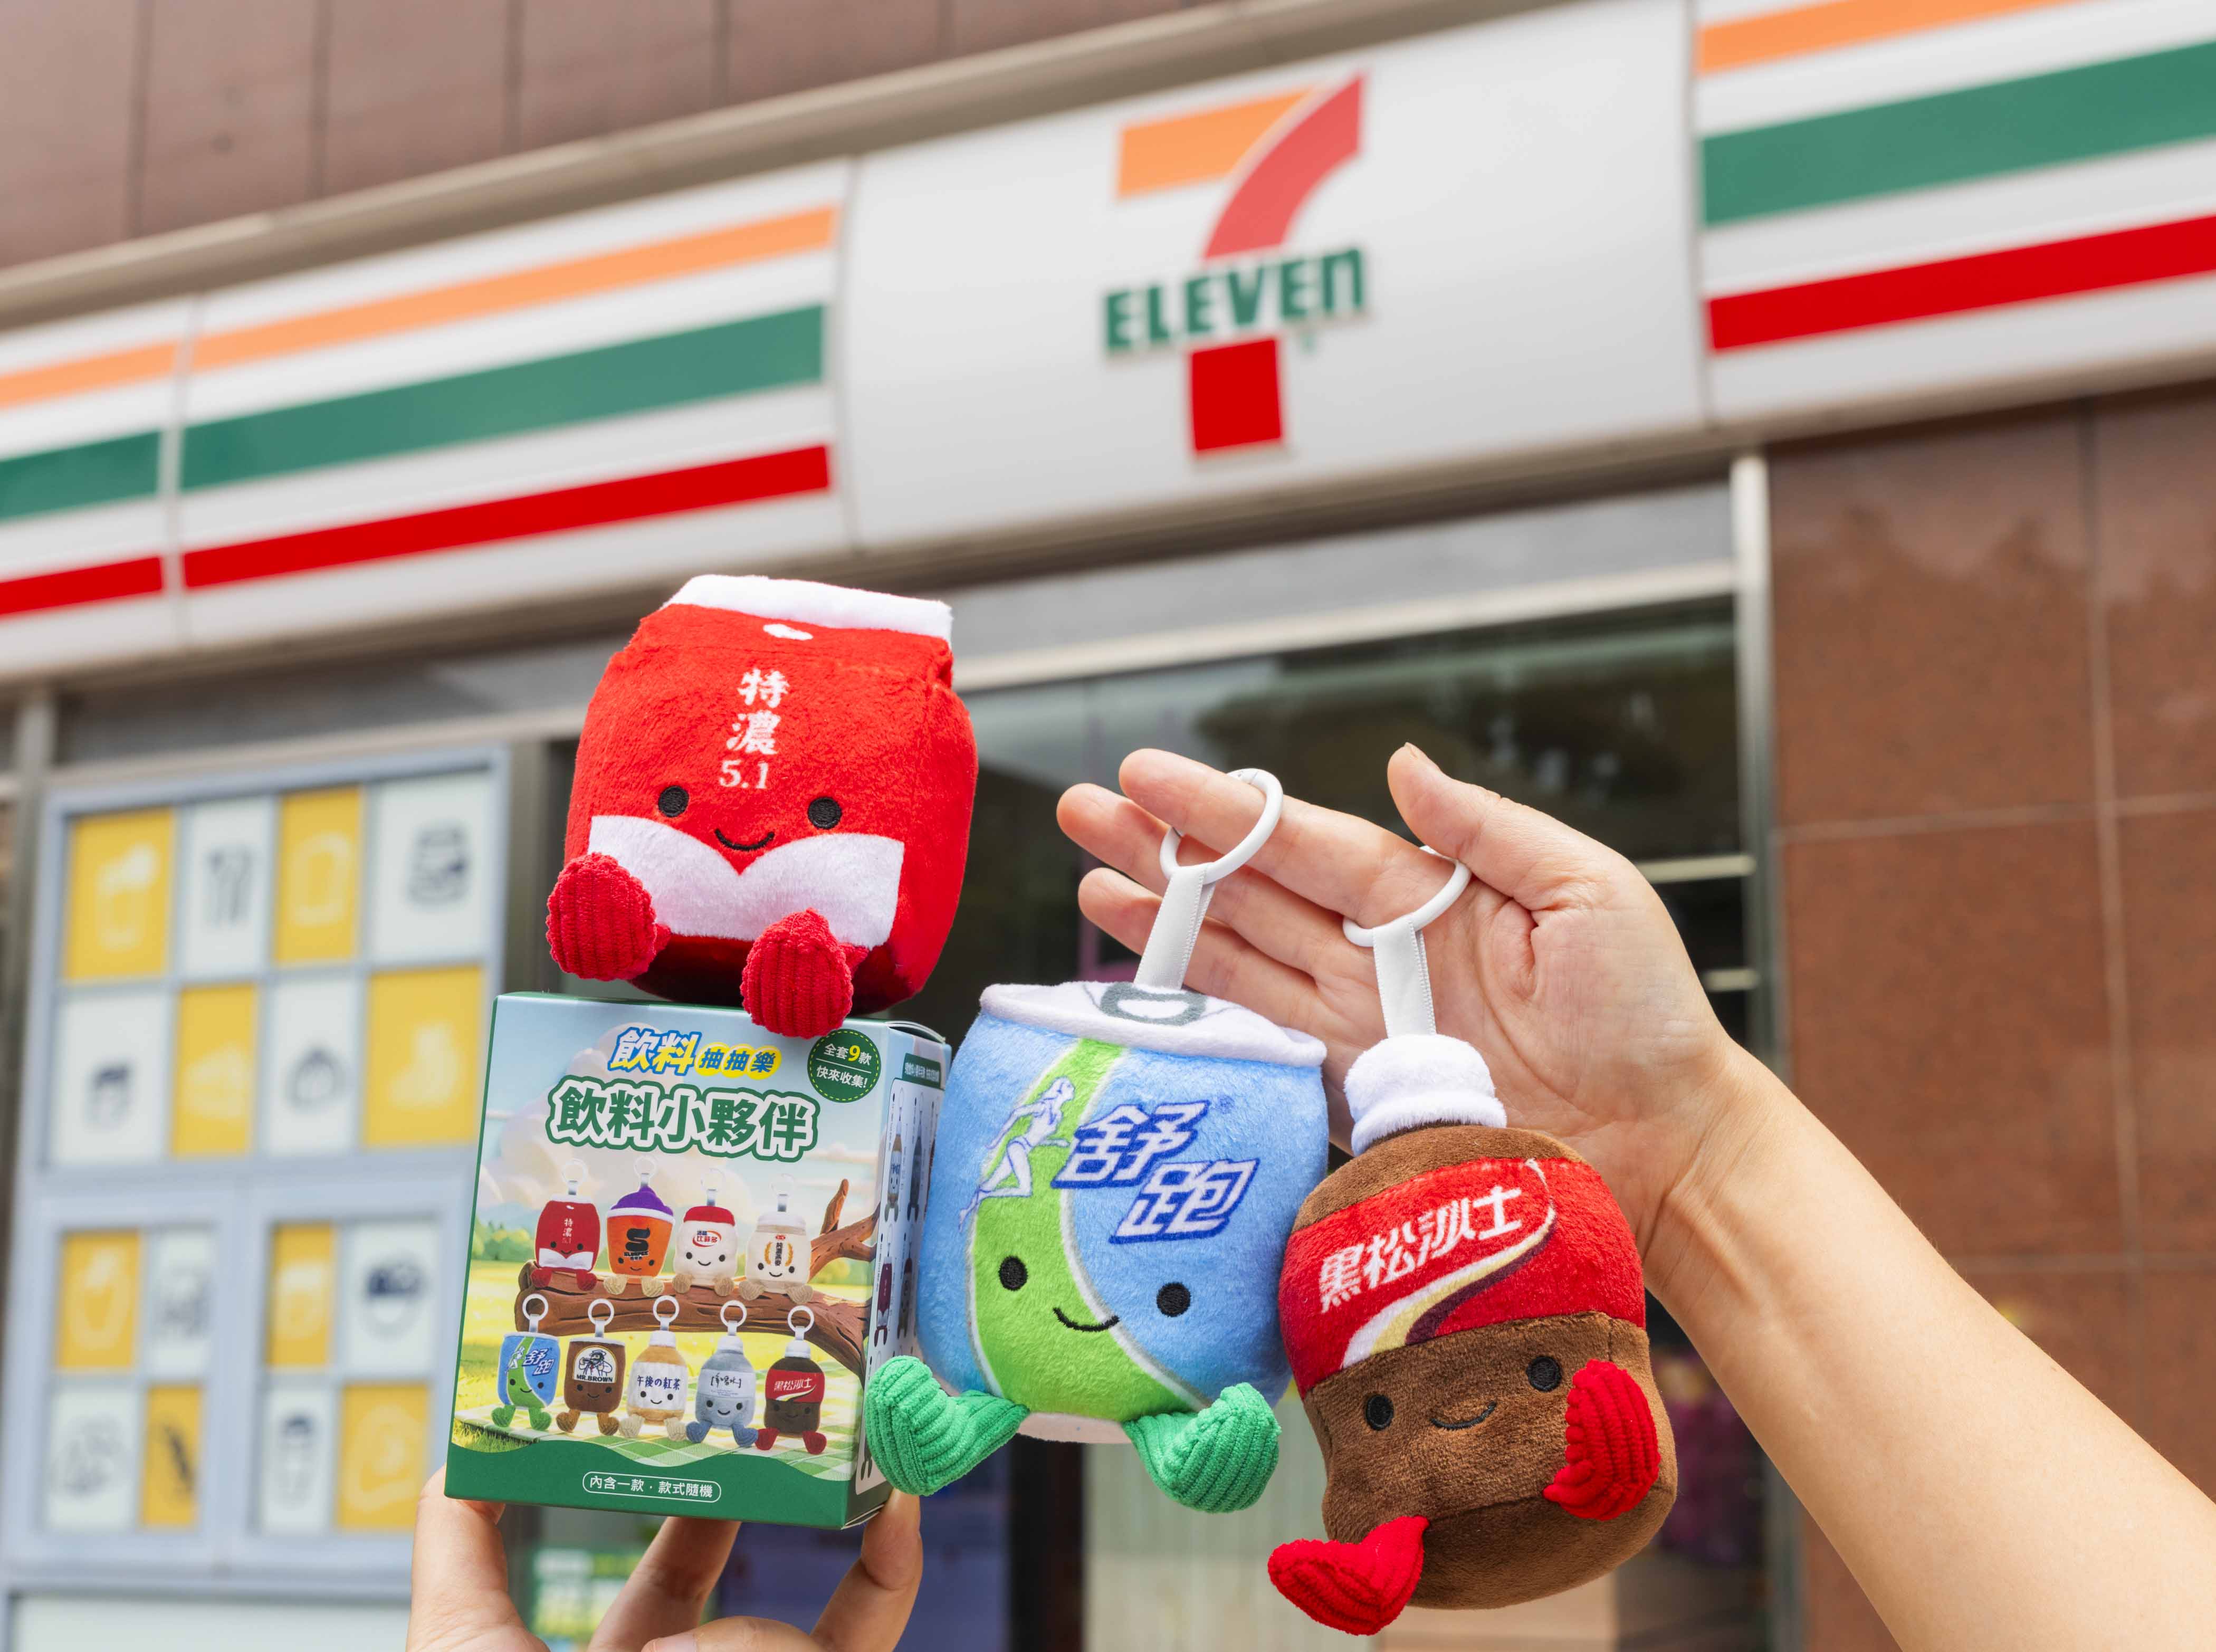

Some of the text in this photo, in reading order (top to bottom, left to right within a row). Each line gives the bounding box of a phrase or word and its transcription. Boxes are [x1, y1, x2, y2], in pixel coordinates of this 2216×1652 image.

[726, 667, 790, 755] 特濃
[718, 758, 769, 789] 5.1
[823, 1043, 872, 1066] 全套9款
[816, 1065, 868, 1088] 快來收集!
[553, 1082, 811, 1154] 飲料小夥伴
[1050, 1099, 1261, 1244] 舒跑
[1320, 1185, 1523, 1313] 黑松沙士
[522, 1348, 555, 1376] 舒跑
[637, 1375, 681, 1391] 午後の紅茶
[773, 1377, 813, 1391] 黑松沙士
